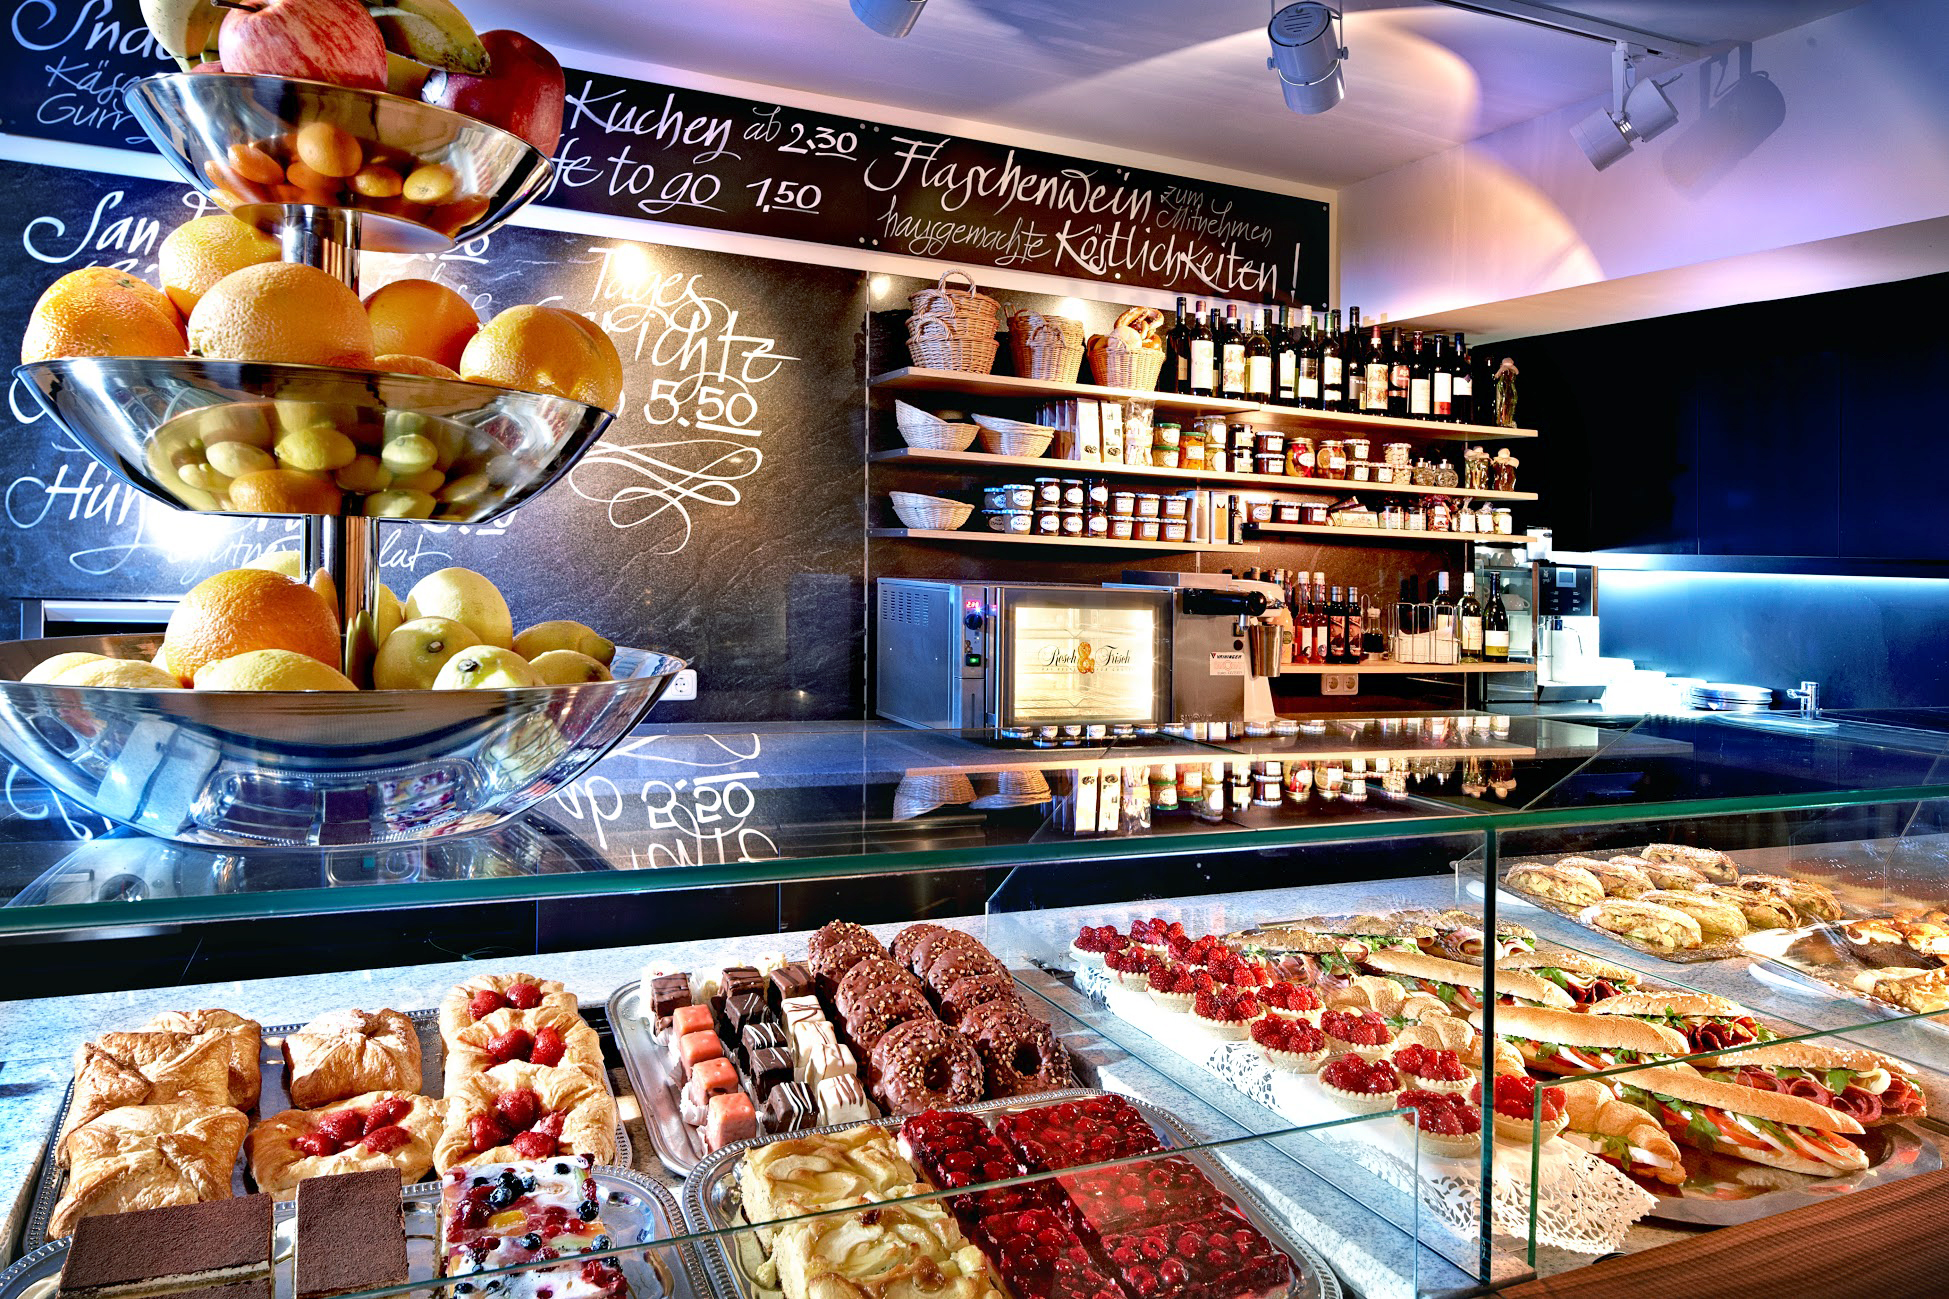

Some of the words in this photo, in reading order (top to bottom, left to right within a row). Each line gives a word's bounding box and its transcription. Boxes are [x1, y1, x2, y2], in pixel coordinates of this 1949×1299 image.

[565, 80, 741, 164] Kuchen
[744, 106, 782, 142] ab
[608, 144, 655, 196] to
[638, 172, 728, 214] go
[864, 138, 1152, 224] Flaschenwein
[1161, 185, 1204, 211] zum
[877, 195, 1051, 265] hausgemachte
[1055, 220, 1278, 298] Köstlichkeiten
[1156, 199, 1273, 247] Mitnehmen
